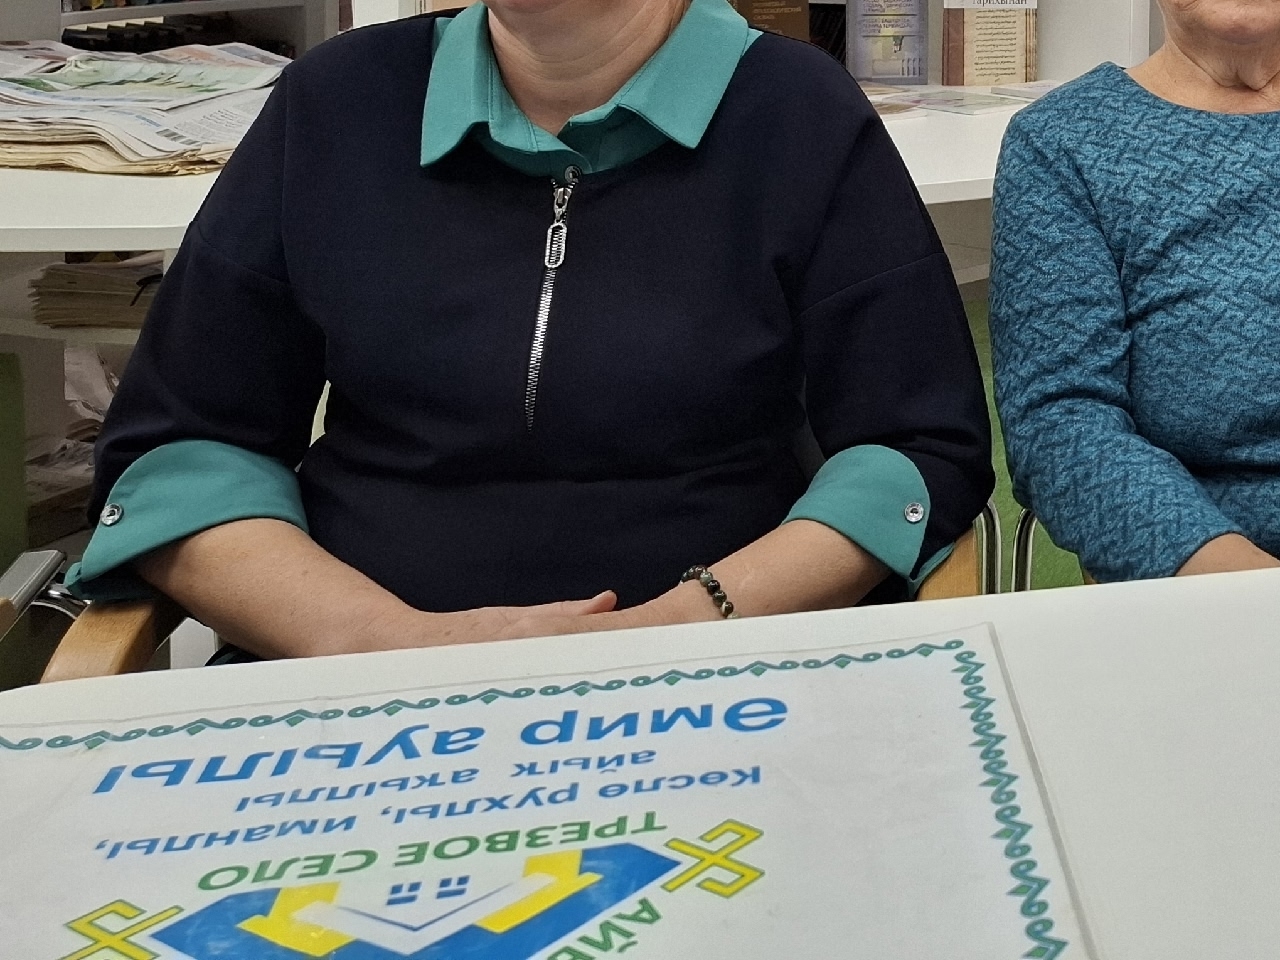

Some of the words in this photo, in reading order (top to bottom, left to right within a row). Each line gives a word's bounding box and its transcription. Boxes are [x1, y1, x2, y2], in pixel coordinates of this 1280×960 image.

[520, 697, 788, 745] Әмир
[93, 724, 486, 794] ауылы
[380, 781, 580, 824] рухлы,
[598, 766, 762, 799] Көслө
[95, 815, 357, 860] иманлы,
[393, 811, 668, 868] ТРЕЗВОЕ
[197, 849, 379, 891] СЕЛО
